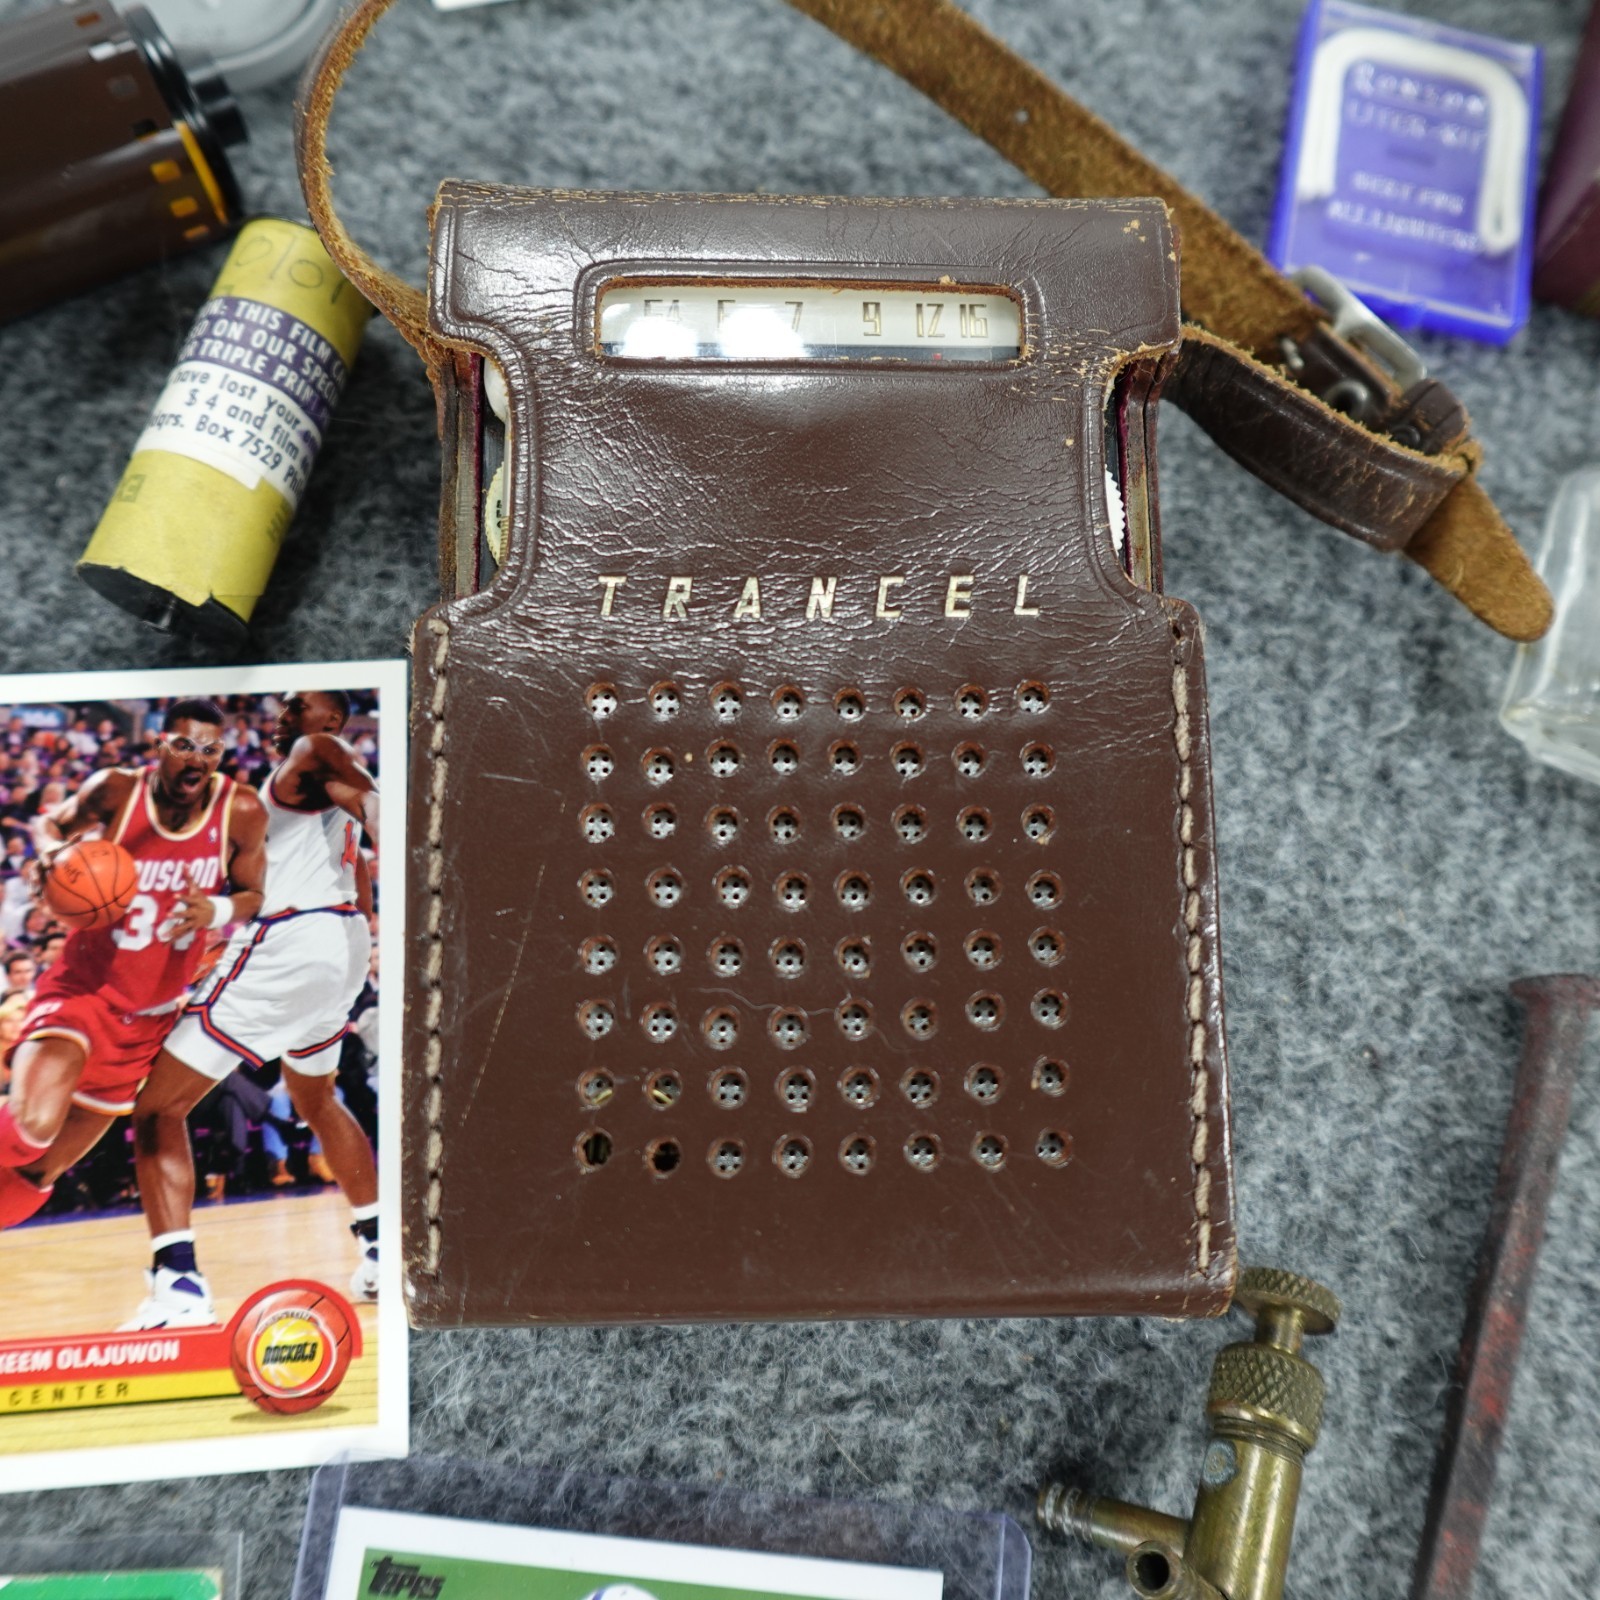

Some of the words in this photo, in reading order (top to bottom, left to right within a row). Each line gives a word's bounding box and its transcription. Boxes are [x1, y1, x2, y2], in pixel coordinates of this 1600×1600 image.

[212, 318, 246, 342] ON
[251, 329, 298, 365] OUR
[235, 301, 283, 331] THIS
[289, 323, 332, 364] FILM
[862, 301, 882, 337] 9
[915, 303, 945, 338] 12
[959, 303, 988, 338] 16
[200, 338, 269, 375] TRIPLE
[219, 373, 258, 401] lost
[264, 395, 302, 431] your
[195, 414, 235, 445] Box
[239, 430, 284, 471] 7529
[226, 404, 268, 431] and
[270, 424, 301, 462] film
[598, 574, 1040, 620] TRANCEL
[56, 1338, 181, 1371] OLAJUWON
[9, 1380, 130, 1408] CENTER
